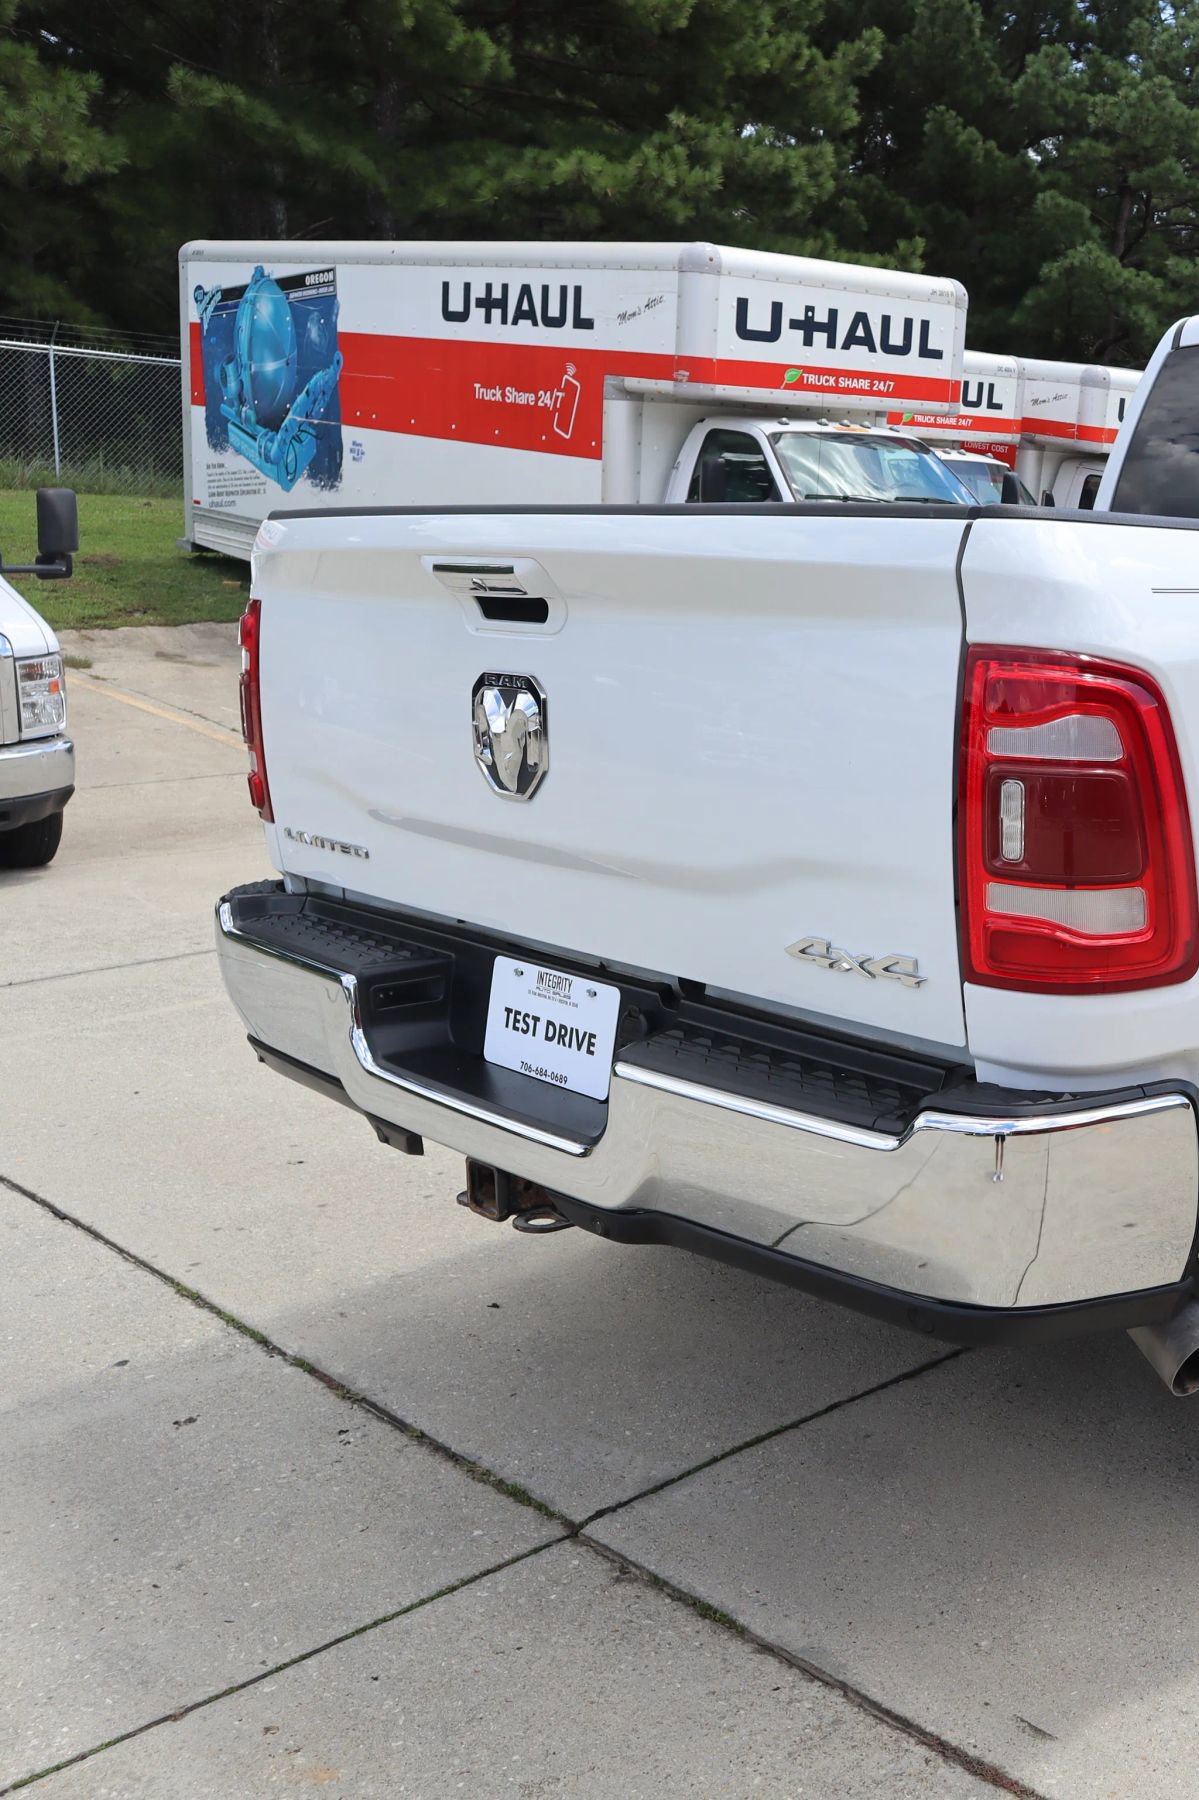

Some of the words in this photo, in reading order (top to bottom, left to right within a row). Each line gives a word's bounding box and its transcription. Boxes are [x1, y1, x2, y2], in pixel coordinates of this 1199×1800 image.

[305, 270, 334, 286] OREGON
[802, 373, 836, 387] TRUCK
[838, 377, 871, 390] SHARE
[872, 380, 895, 392] 24/7
[474, 383, 502, 402] Truck
[505, 386, 535, 406] Share
[538, 388, 564, 411] 24/7
[914, 414, 935, 424] TRUCK
[936, 416, 957, 426] SHARE
[958, 418, 973, 427] 24/7
[964, 441, 990, 451] LOWEST
[991, 443, 1009, 453] COST
[484, 674, 528, 688] RAM
[284, 827, 369, 859] LIMITED
[536, 970, 573, 993] INTEGRITY
[504, 1006, 541, 1037] TEST
[544, 1019, 597, 1056] DRIVE
[519, 1061, 568, 1085] 706-684-0689
